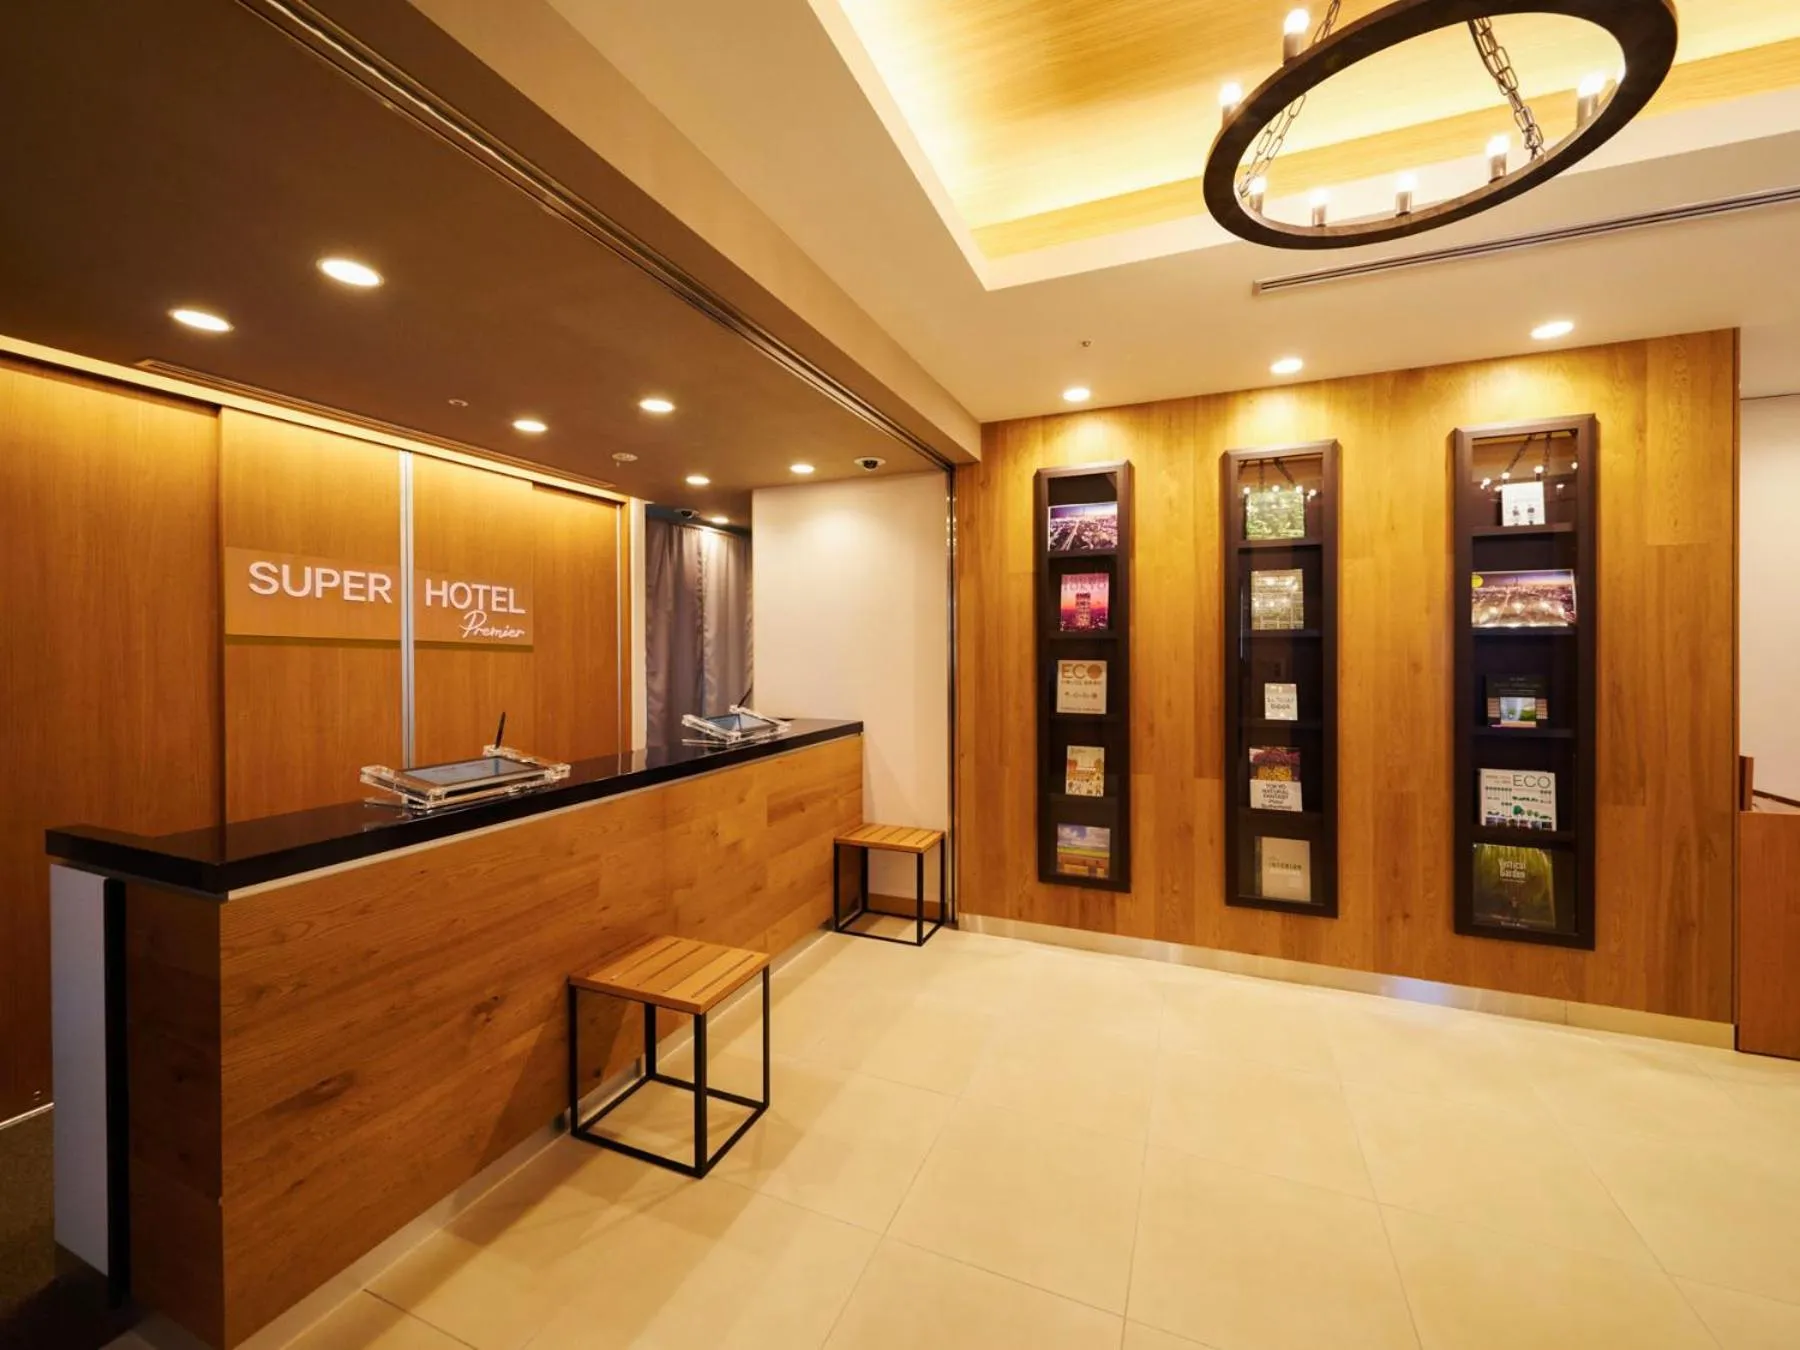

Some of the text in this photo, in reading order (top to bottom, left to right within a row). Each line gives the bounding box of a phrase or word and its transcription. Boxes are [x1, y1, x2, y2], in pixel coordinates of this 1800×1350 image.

[248, 561, 526, 615] SUPER HOTEL
[459, 609, 525, 639] Premier
[1512, 774, 1552, 789] ECO
